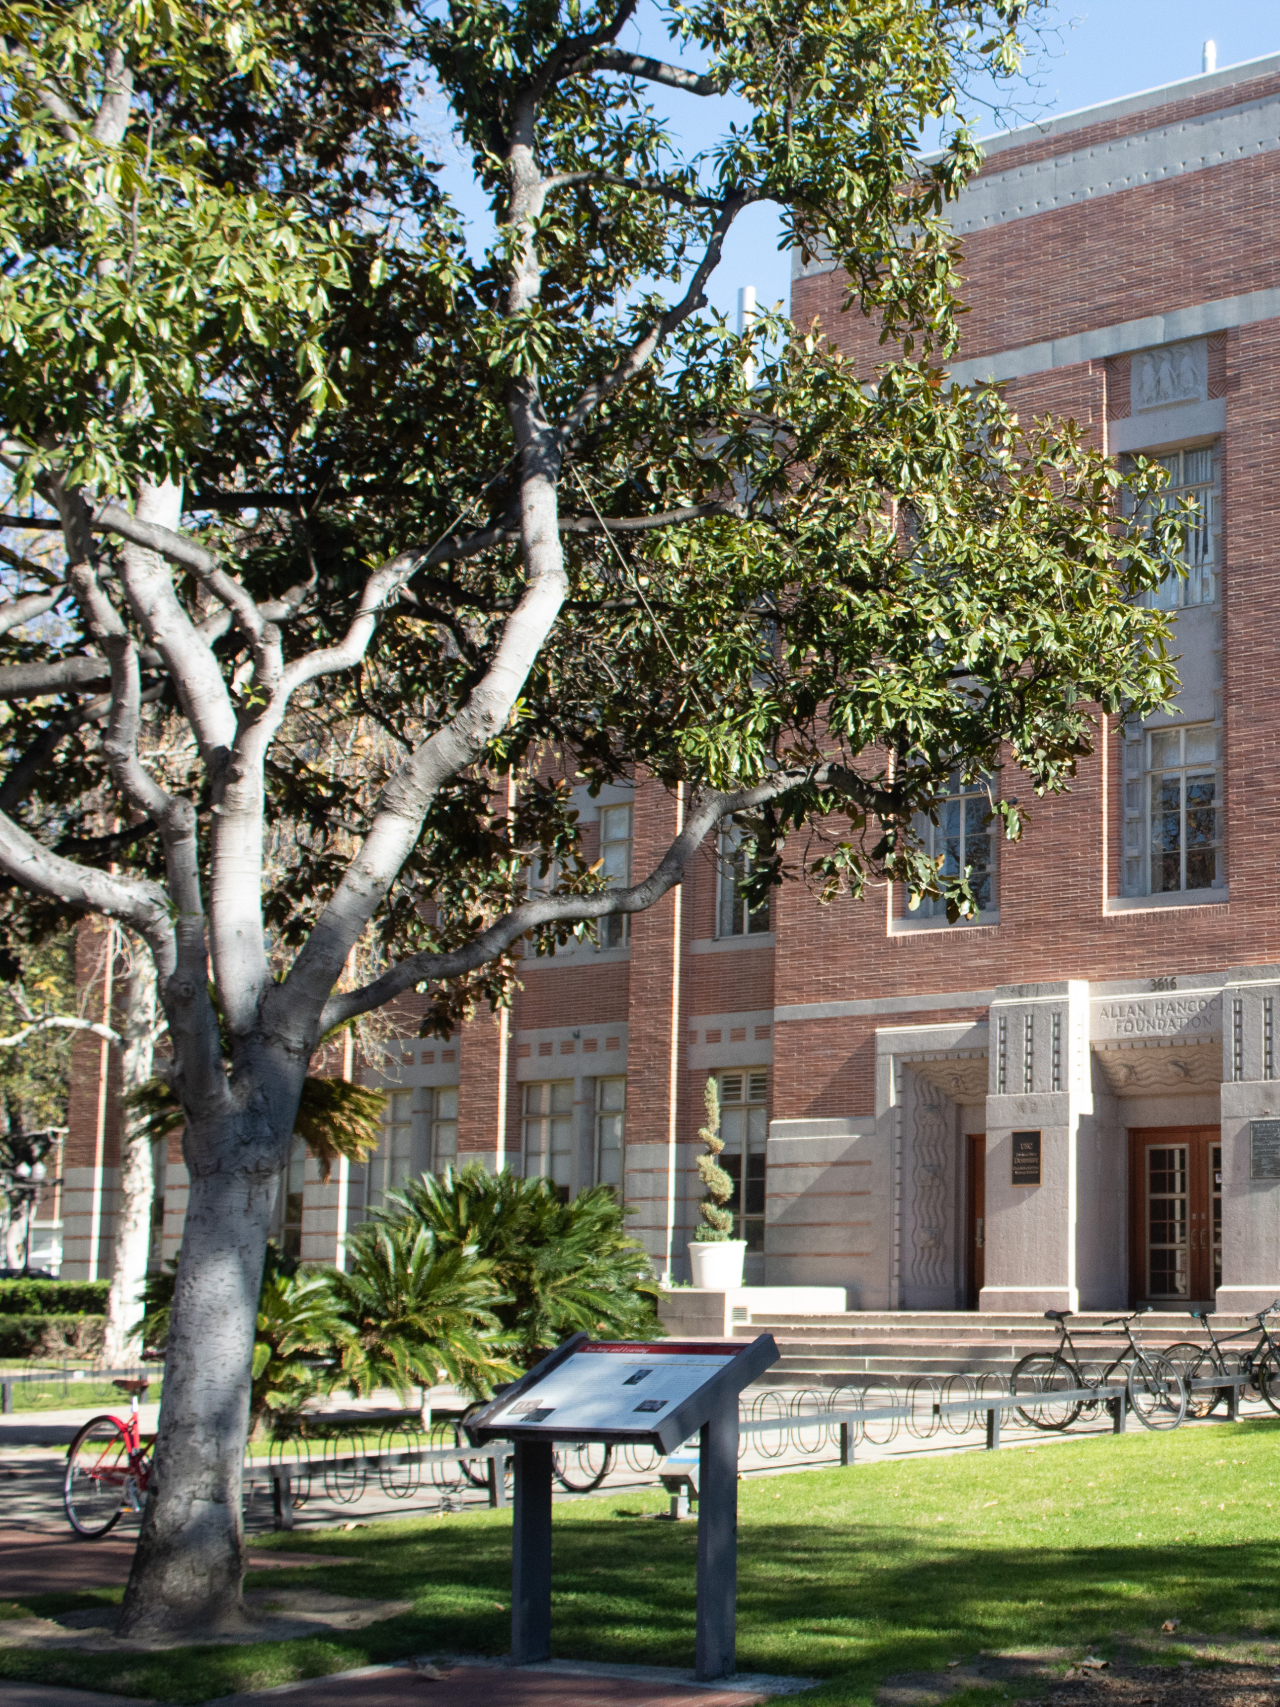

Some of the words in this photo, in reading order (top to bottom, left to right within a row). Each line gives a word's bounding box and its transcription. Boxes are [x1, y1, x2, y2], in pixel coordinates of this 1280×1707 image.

[1149, 977, 1177, 992] 3616
[1100, 1004, 1146, 1019] ALLAN
[1154, 999, 1223, 1017] HANCOC
[1115, 1014, 1212, 1033] FOUNDATION
[622, 1347, 649, 1355] Learning
